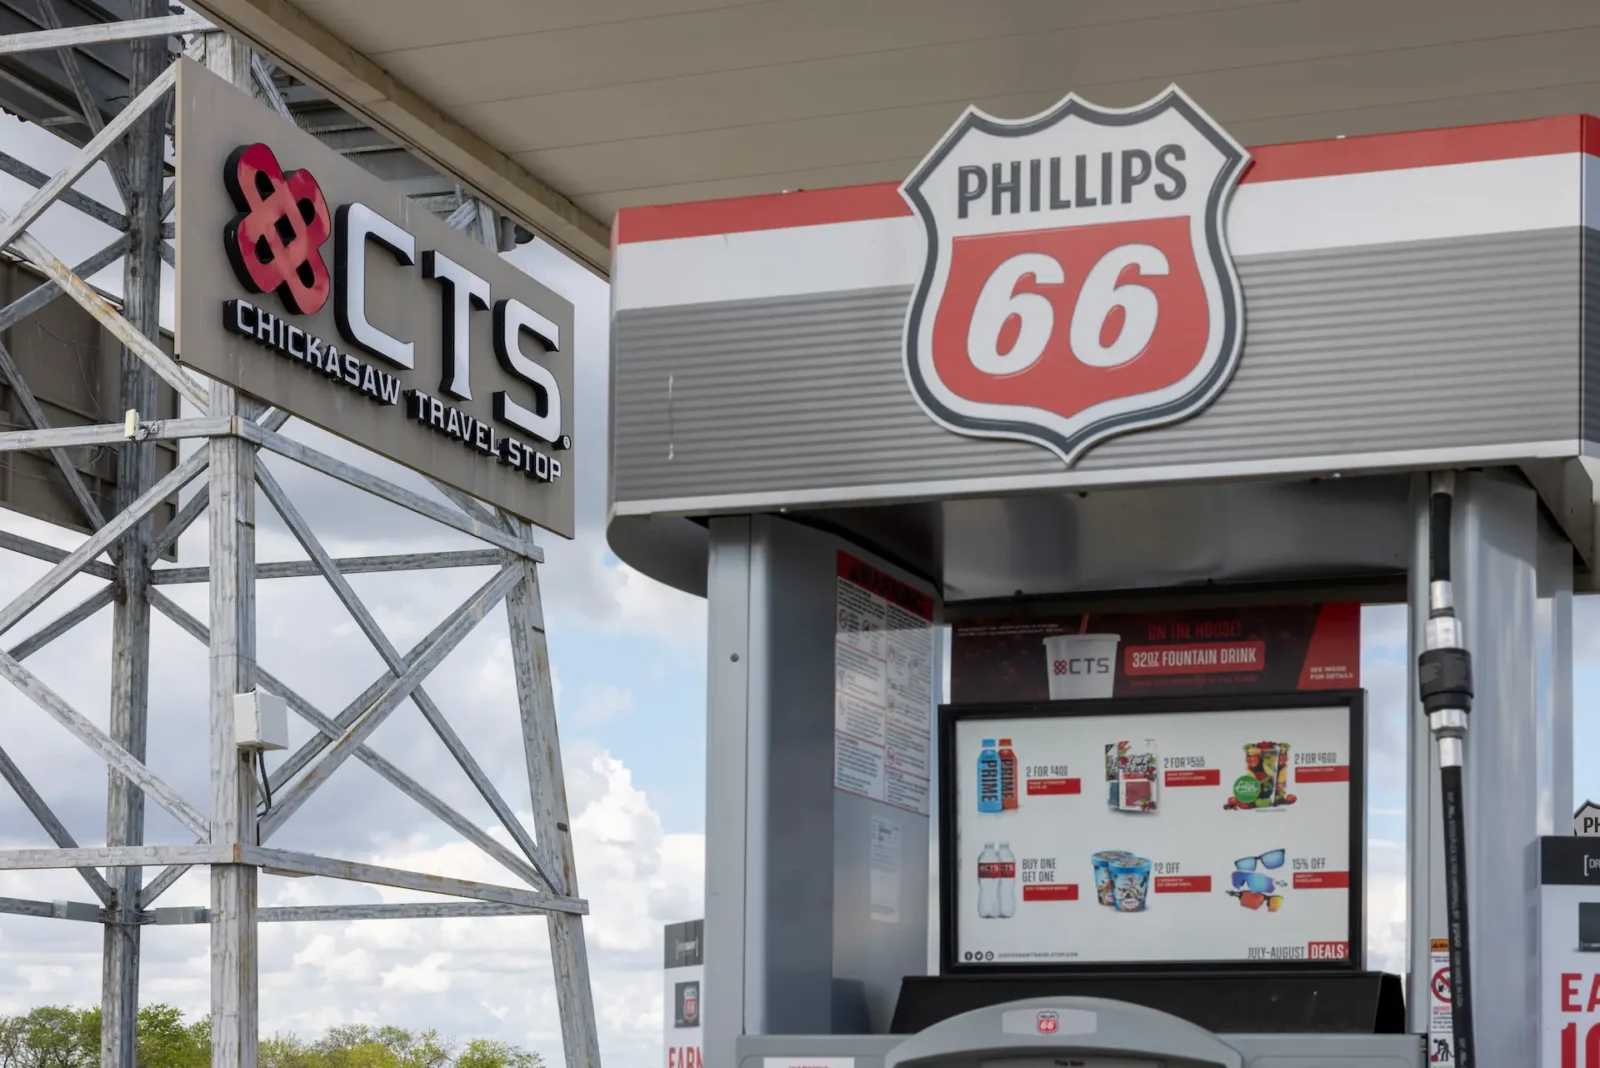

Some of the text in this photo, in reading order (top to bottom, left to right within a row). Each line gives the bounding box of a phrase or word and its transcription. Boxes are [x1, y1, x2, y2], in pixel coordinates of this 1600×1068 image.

[957, 143, 1188, 220] PHILLIPS
[966, 242, 1171, 379] 66
[335, 201, 562, 445] CTS
[224, 298, 564, 485] CHICKASAW TRAVEL STOP
[1162, 648, 1218, 668] FOUNTAIN
[1220, 646, 1257, 665] DRINK
[1069, 657, 1110, 675] CTS
[1163, 757, 1170, 768] 2
[1170, 757, 1186, 768] FOR
[1294, 753, 1300, 765] 2
[1301, 753, 1317, 765] FOR
[1026, 766, 1032, 778] 2
[1033, 765, 1049, 777] FOR
[981, 759, 999, 803] PRIME
[1022, 858, 1056, 870] BUY ONE
[1166, 862, 1180, 874] OFF
[1311, 857, 1326, 869] OFF
[1022, 871, 1055, 883] GET ONE
[1311, 944, 1345, 959] DEALS
